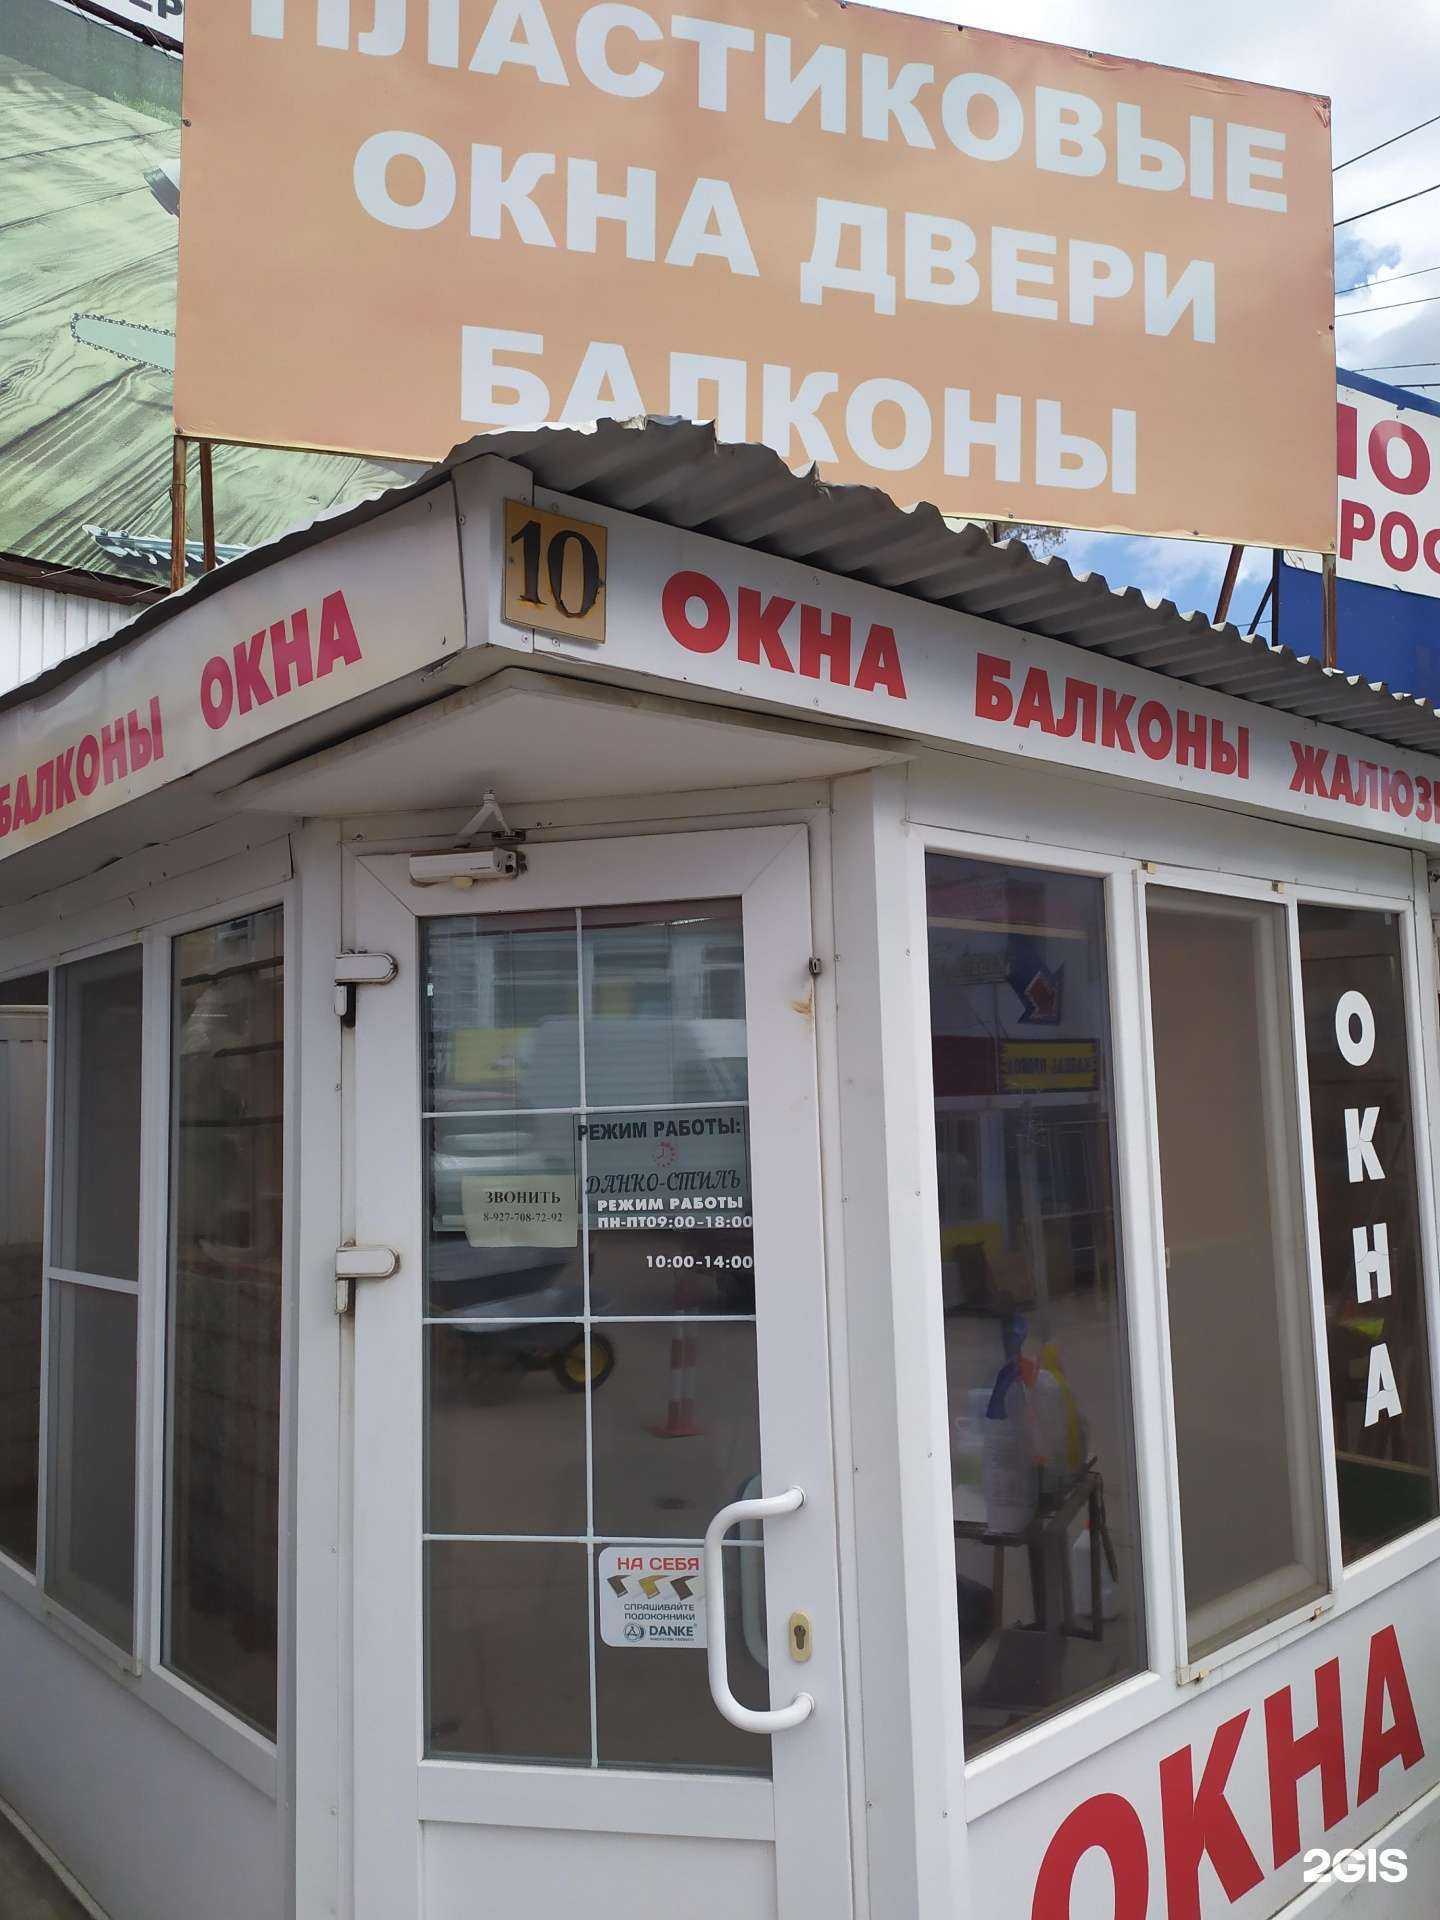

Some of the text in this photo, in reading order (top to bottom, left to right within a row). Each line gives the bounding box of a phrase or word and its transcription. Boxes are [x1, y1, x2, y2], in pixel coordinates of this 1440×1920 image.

[353, 131, 1216, 344] ОКНА ДВЕРИ
[511, 520, 601, 618] 10
[662, 570, 907, 699] ОКНА
[975, 652, 1249, 779] БАЛКОНЫ
[0, 590, 362, 838] БАЛКОНЫ ОКНА
[577, 1117, 743, 1141] РЕЖИМ РАБОТЫ:
[484, 1191, 561, 1204] ЗВОНИТЬ
[597, 1196, 743, 1212] РЕЖИМ РАБОТЫ
[1335, 990, 1402, 1427] ОКНА
[646, 1255, 753, 1269] 10:00-14:00
[616, 1557, 700, 1571] НА СЕБЯ
[623, 1602, 695, 1612] СПРАШИВАЙТЕ
[649, 1625, 694, 1637] DANKE
[1031, 1624, 1425, 1920] ОКНА
